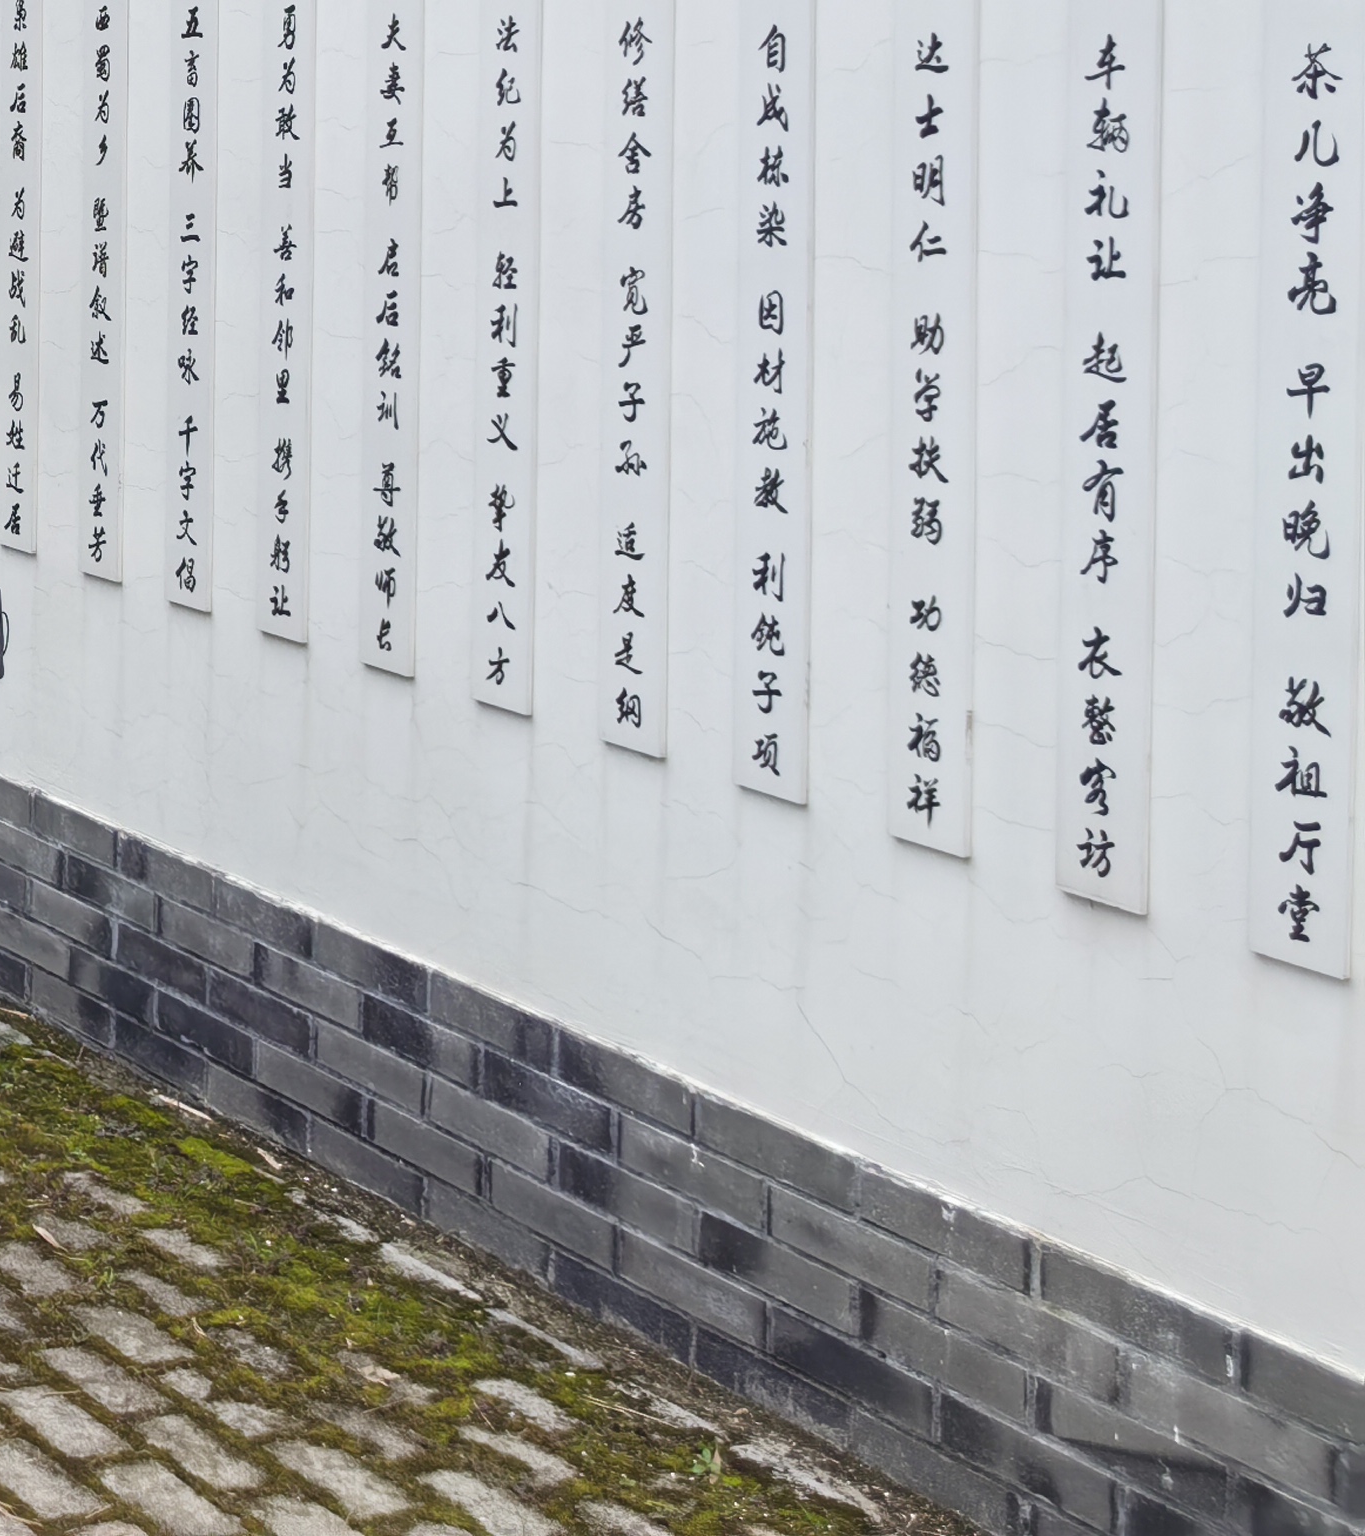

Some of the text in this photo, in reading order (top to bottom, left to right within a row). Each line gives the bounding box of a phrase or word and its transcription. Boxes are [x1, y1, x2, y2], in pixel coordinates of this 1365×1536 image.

[93, 5, 112, 166] 西蜀为乡
[177, 5, 206, 183] 五畜圈养
[274, 4, 302, 189] 勇为敢当
[378, 13, 408, 203] 夫妻互帮
[491, 15, 522, 209] 法纪为上
[908, 32, 950, 262] 达士明仁
[1083, 33, 1130, 282] 车辆礼让
[1286, 43, 1344, 316] 茶几净亮
[7, 186, 30, 345] 为避战乱
[176, 213, 202, 385] 三字经咏
[485, 251, 519, 451] 轻利重义
[5, 372, 27, 536] 易姓迁居
[613, 266, 650, 477] 宽严子孙
[751, 289, 790, 514] 因材施教
[907, 313, 950, 546] 助学扶弱
[1079, 332, 1128, 584] 起居有序
[87, 399, 110, 564] 万代垂芳
[373, 462, 402, 652] 尊敬师长
[1281, 363, 1332, 618] 早出晚归
[484, 484, 517, 686] 挚友八方
[751, 552, 786, 777] 利钝子项
[905, 595, 943, 824] 功德福祥
[1075, 626, 1124, 878] 衣整客访
[1273, 676, 1333, 943] 敬祖厅堂
